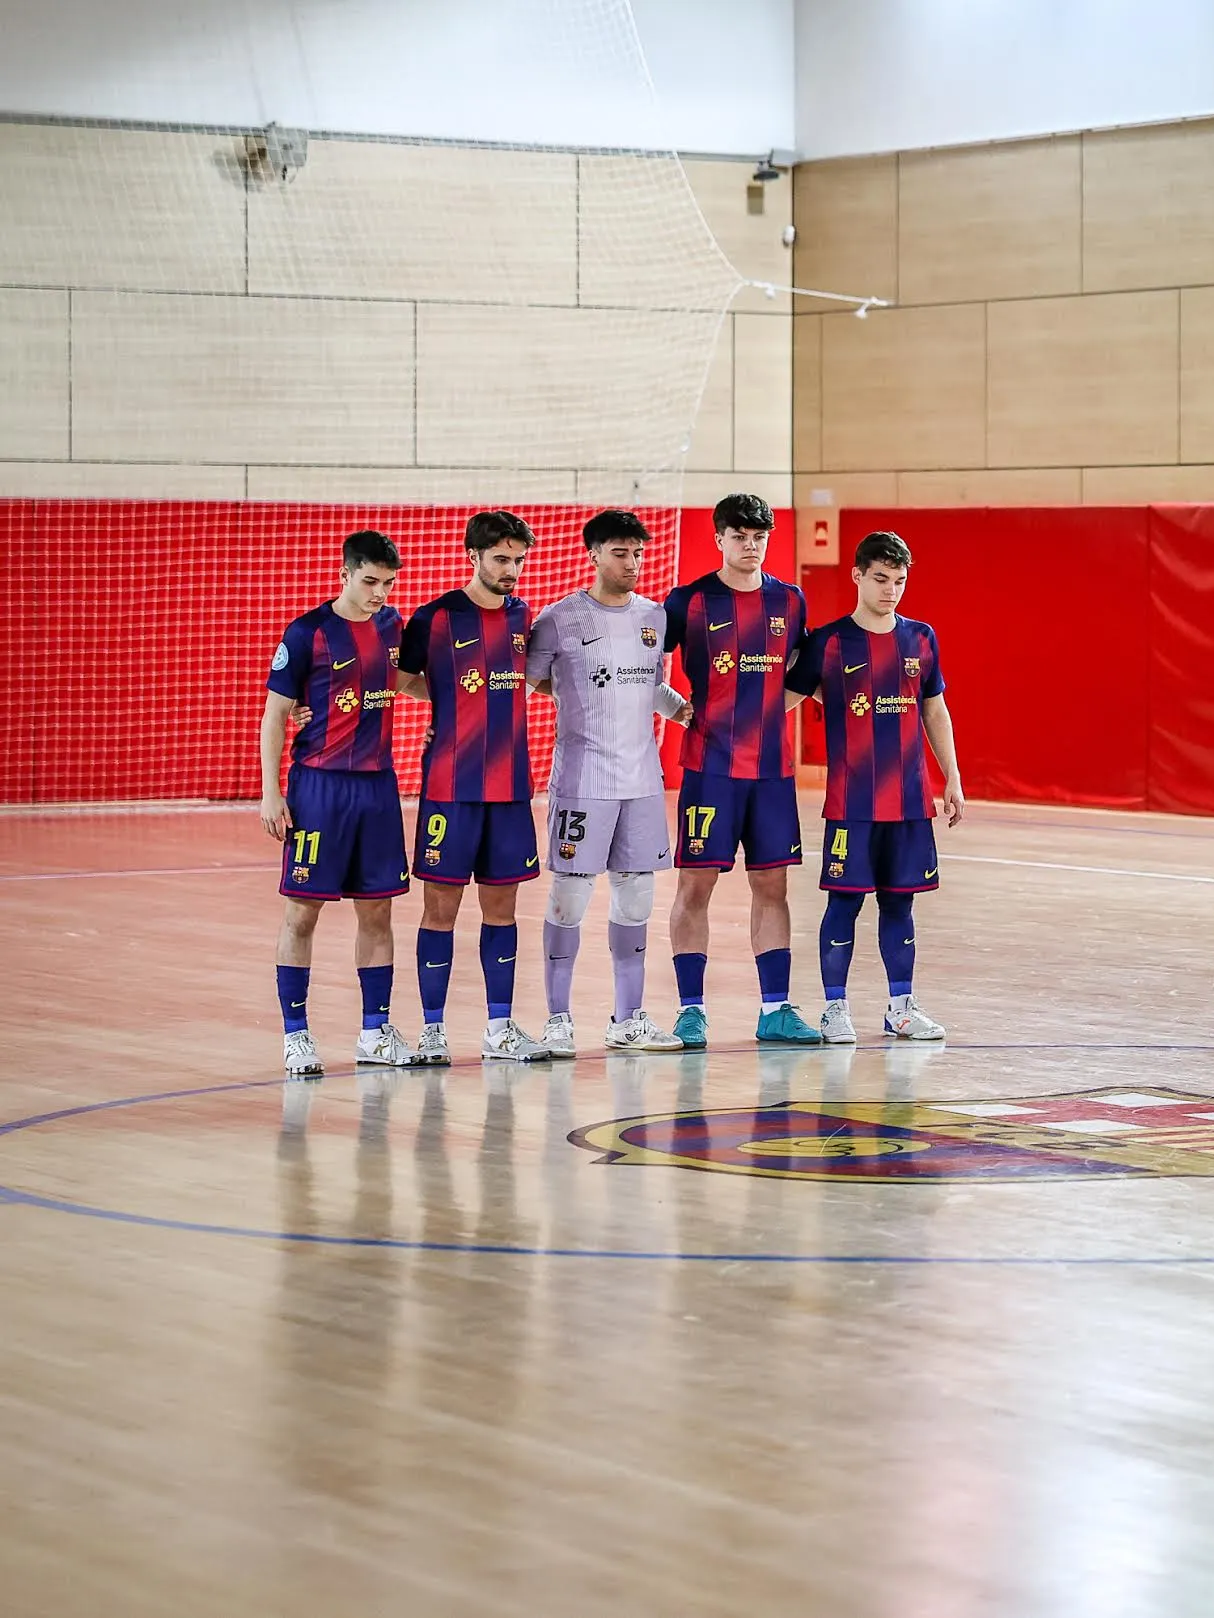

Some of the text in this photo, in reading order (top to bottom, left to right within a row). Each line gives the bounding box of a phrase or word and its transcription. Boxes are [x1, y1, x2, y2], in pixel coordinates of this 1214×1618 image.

[427, 813, 448, 847] 9
[558, 809, 587, 842] 13
[685, 805, 717, 839] 17
[293, 829, 322, 865] 11
[831, 828, 849, 860] 4
